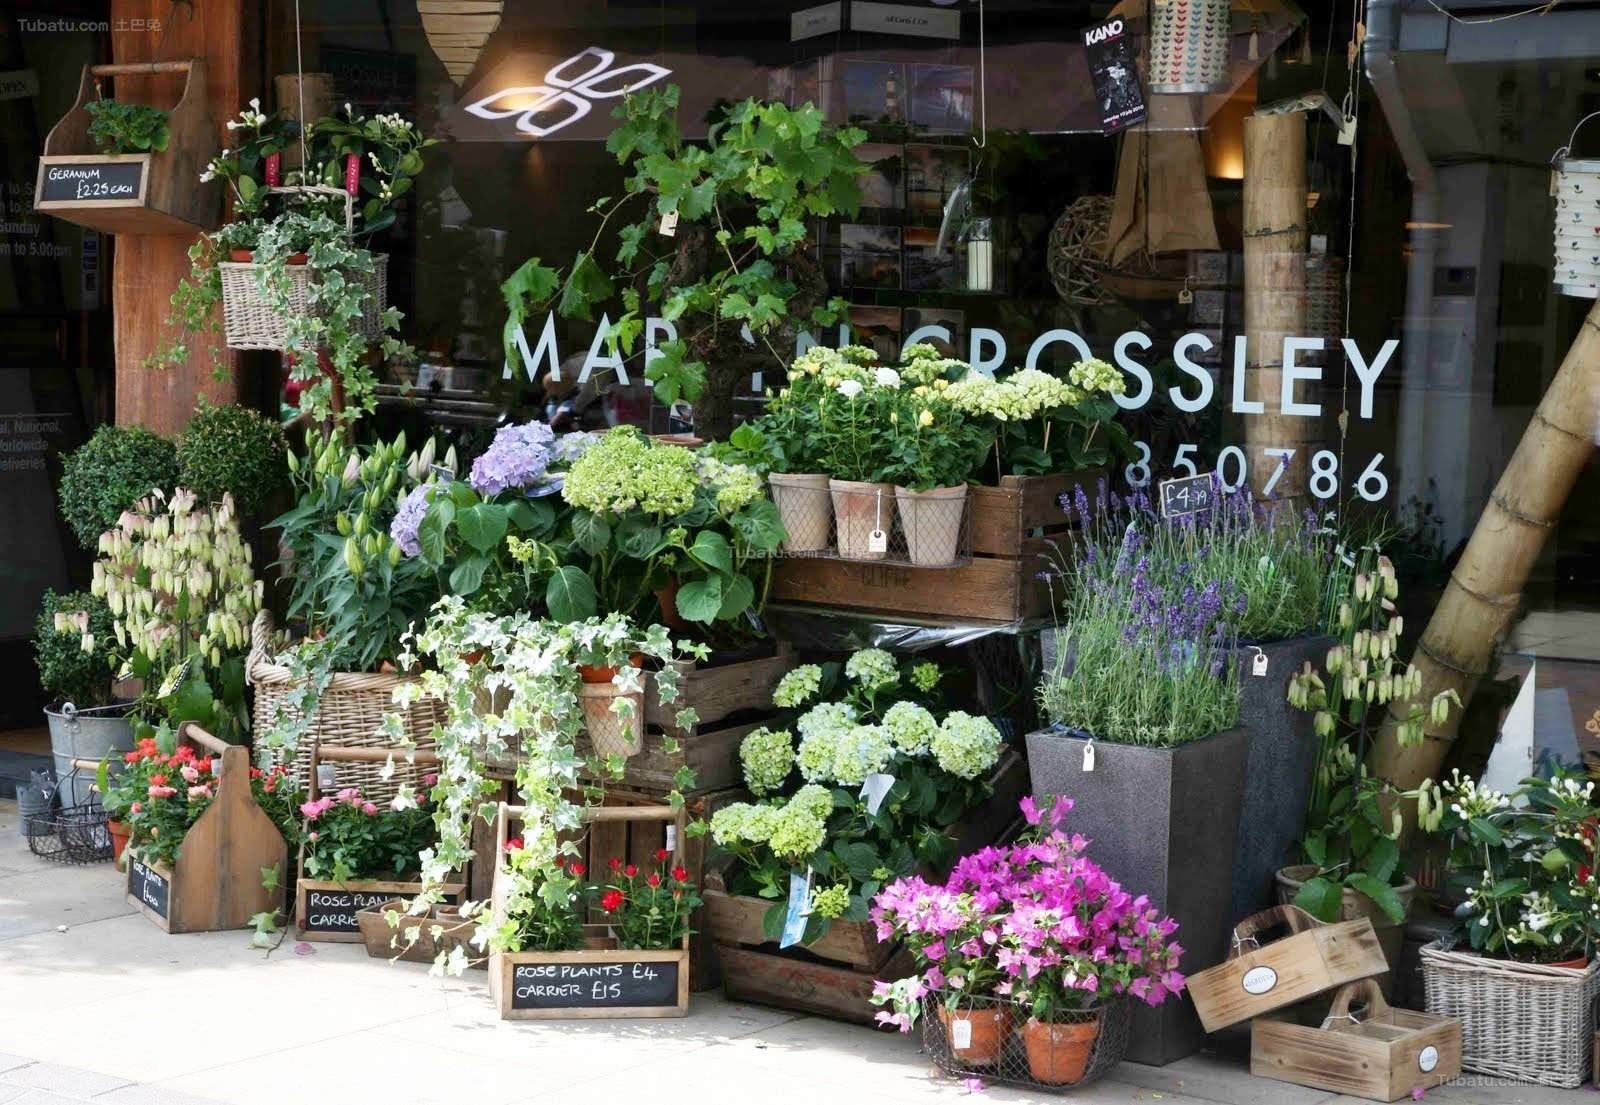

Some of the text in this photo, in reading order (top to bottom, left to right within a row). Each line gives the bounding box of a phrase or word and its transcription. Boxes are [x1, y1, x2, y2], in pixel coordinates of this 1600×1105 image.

[1085, 20, 1123, 46] KANO
[49, 168, 100, 180] GERANIUM
[77, 180, 109, 199] £2.25
[1125, 441, 1388, 501] 850786
[311, 893, 389, 907] ROSE PLAN
[309, 914, 359, 927] CARRIE
[516, 963, 658, 980] ROSE PLANTS £4
[516, 980, 621, 999] CARRIER £15
